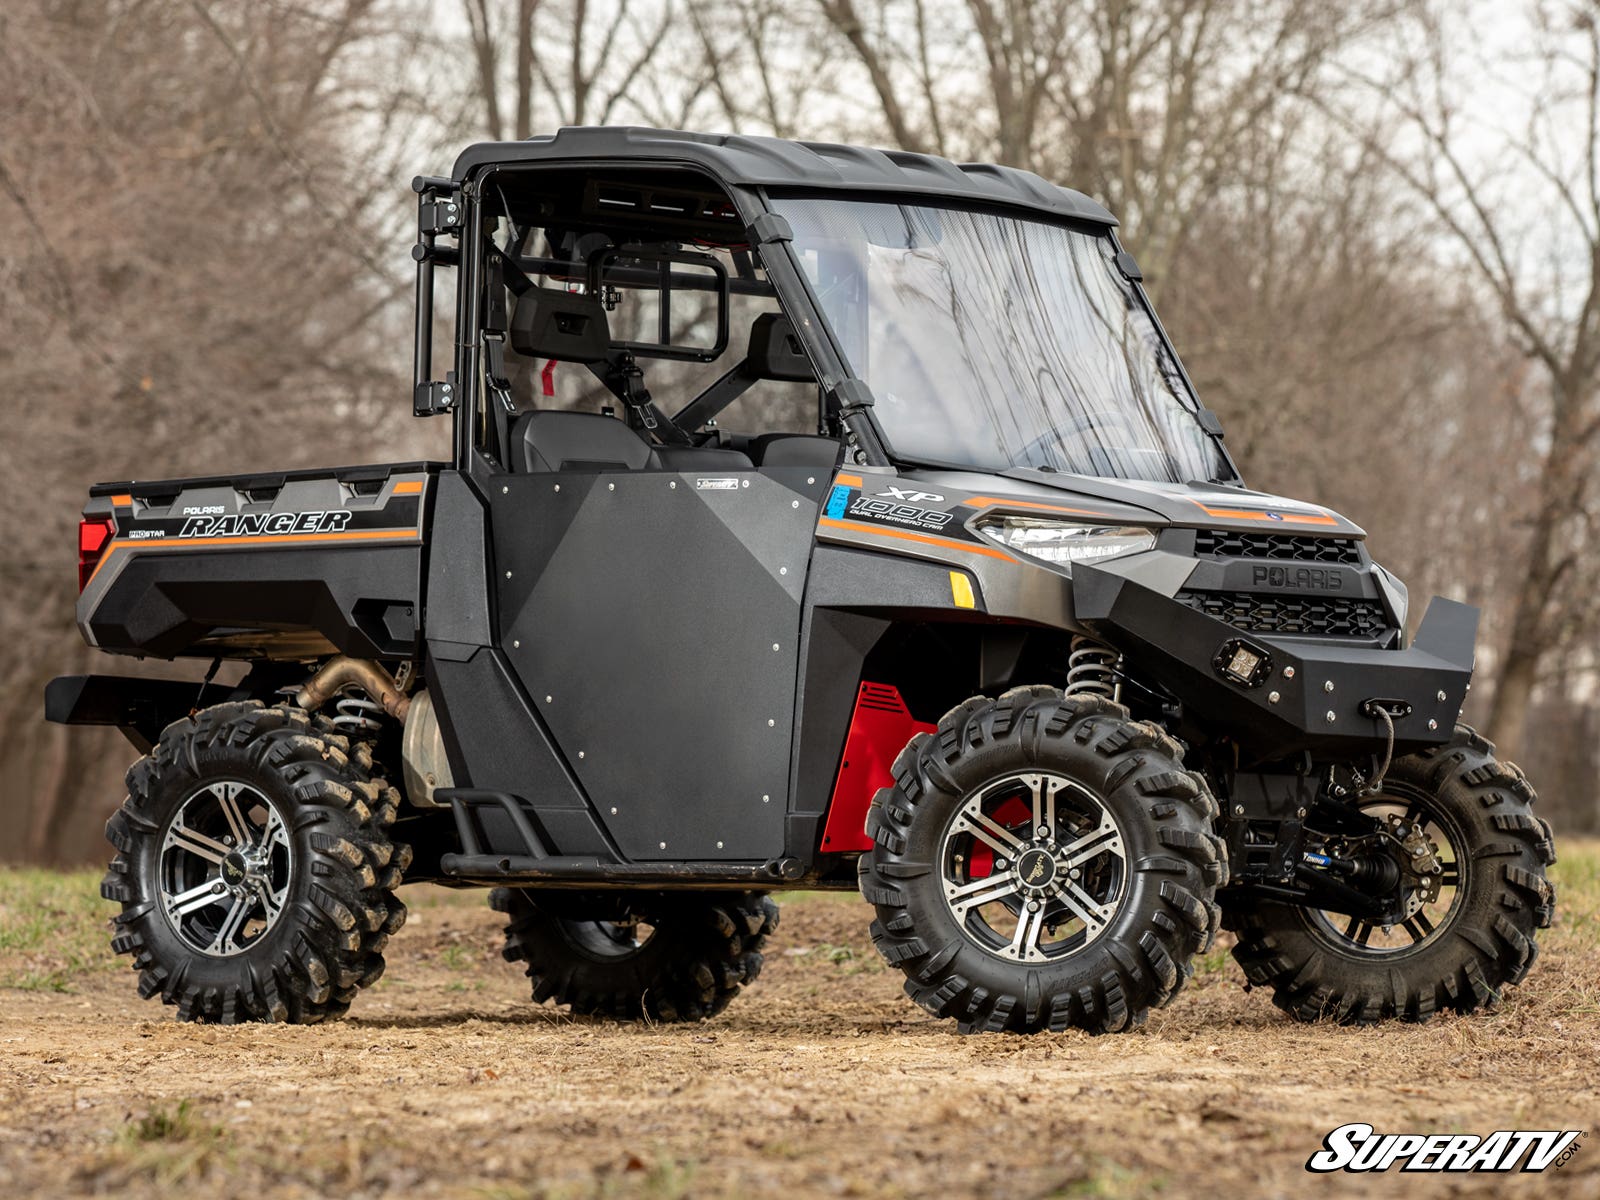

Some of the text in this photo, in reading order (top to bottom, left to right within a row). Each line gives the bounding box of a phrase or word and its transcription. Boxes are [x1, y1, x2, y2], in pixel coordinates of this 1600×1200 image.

[873, 485, 945, 502] XP
[183, 506, 225, 515] POLARIS
[850, 509, 944, 531] DUAL OVERHEAD CAM
[851, 497, 953, 526] 1000
[179, 510, 352, 537] RANGER
[1252, 566, 1343, 590] POLARIS
